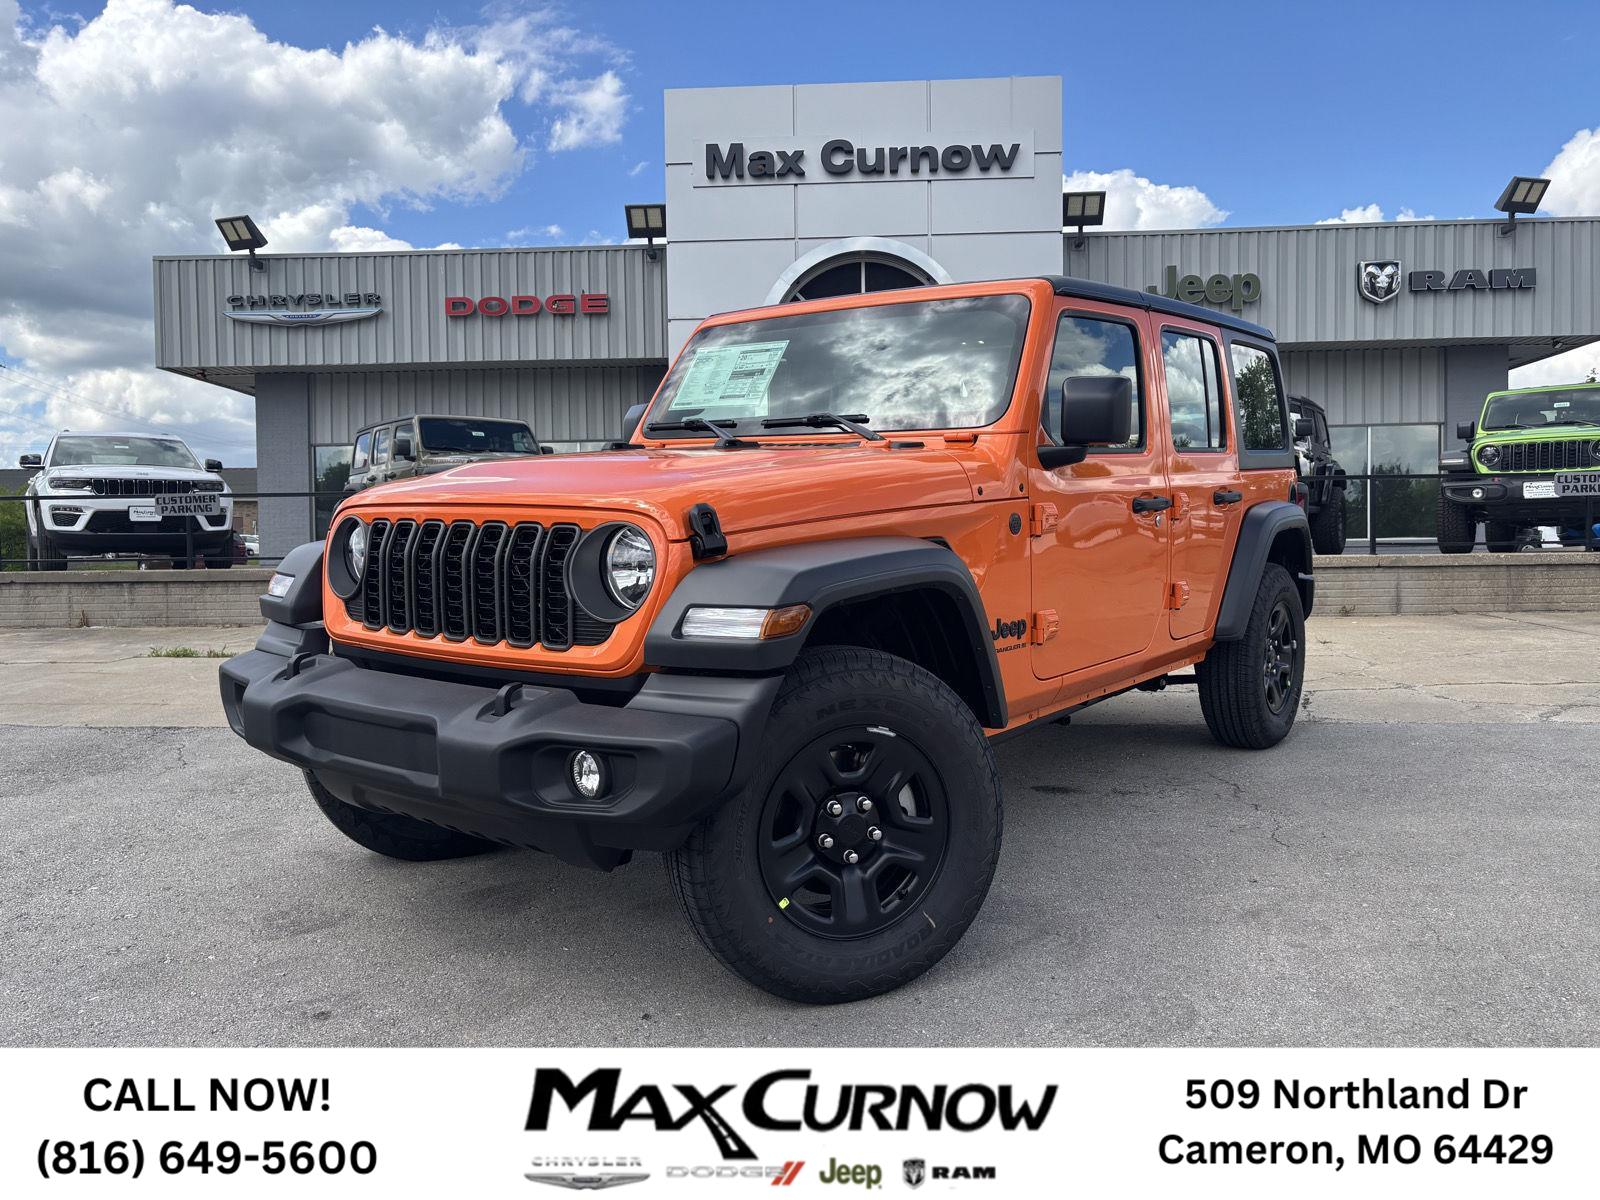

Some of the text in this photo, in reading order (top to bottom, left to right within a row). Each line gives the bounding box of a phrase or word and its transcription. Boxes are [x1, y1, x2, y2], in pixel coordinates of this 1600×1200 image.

[705, 139, 1021, 179] Max Curnow
[1147, 265, 1262, 310] Jeep
[1408, 268, 1537, 293] RAM
[226, 293, 383, 307] CHRYSLER
[445, 292, 609, 317] DODGE
[1557, 474, 1600, 484] CUSTO
[156, 494, 217, 506] CUSTOMER
[161, 504, 213, 515] PARKING
[991, 618, 1027, 640] Jeep
